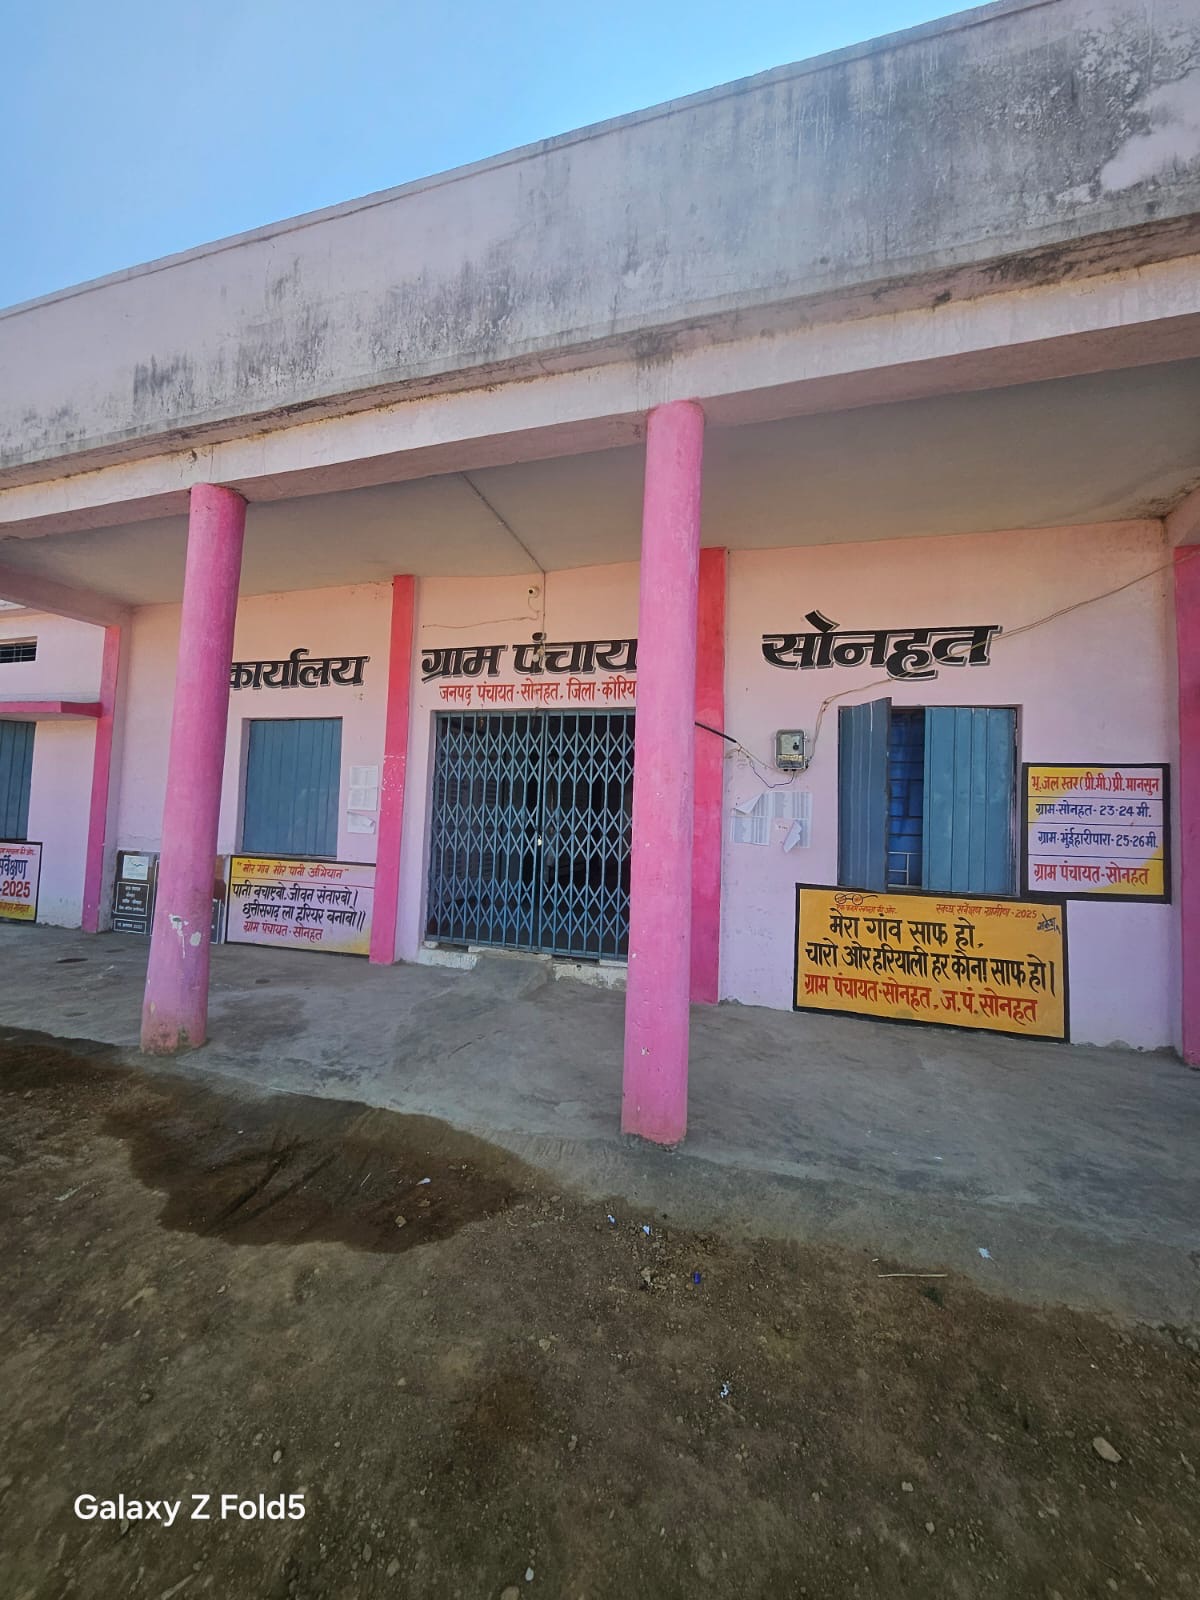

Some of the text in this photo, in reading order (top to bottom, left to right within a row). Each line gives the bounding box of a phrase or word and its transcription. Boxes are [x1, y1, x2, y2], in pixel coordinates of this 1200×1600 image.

[230, 609, 1003, 690] कार्यालय ग्राम पंचाय सोनहत
[439, 685, 474, 706] जनपद
[1034, 863, 1057, 881] ग्राम
[287, 883, 314, 902] जीवन
[282, 905, 295, 920] ला
[296, 904, 324, 923] हरियर
[1015, 908, 1037, 919] 2025
[244, 920, 259, 934] ग्राम
[829, 907, 860, 939] मेरा
[863, 912, 902, 944] गांव
[908, 920, 948, 948] साफ
[805, 937, 838, 968] चारो
[842, 940, 871, 971] ओर
[872, 943, 929, 978] हरियाली
[930, 952, 951, 983] हर
[951, 949, 988, 983] कोना
[990, 958, 1026, 988] साफ
[804, 973, 830, 995] ग्राम
